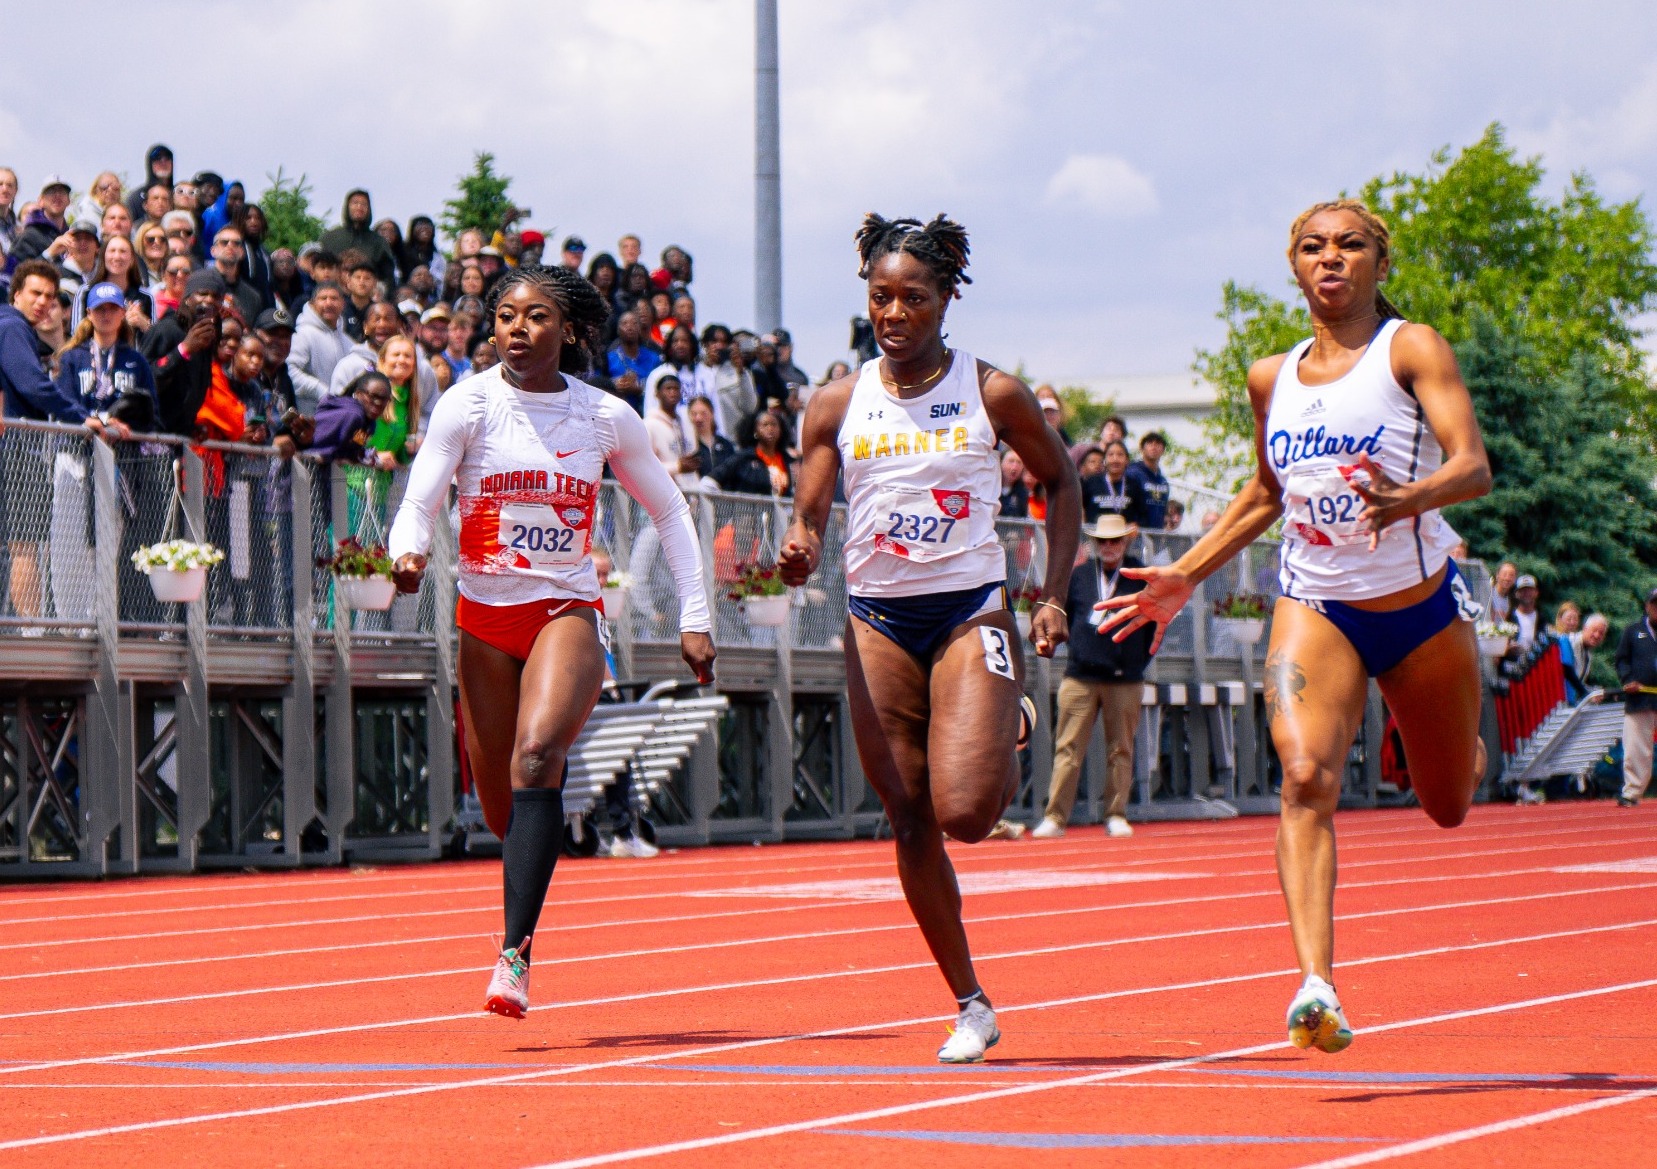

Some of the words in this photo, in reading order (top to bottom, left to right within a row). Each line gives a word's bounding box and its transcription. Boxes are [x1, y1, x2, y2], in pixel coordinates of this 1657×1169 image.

[853, 427, 969, 460] WARNER
[1270, 425, 1386, 469] Dillard
[480, 470, 548, 495] INDIANA
[511, 525, 574, 552] 2032
[888, 512, 956, 543] 2327
[989, 629, 1010, 674] 3
